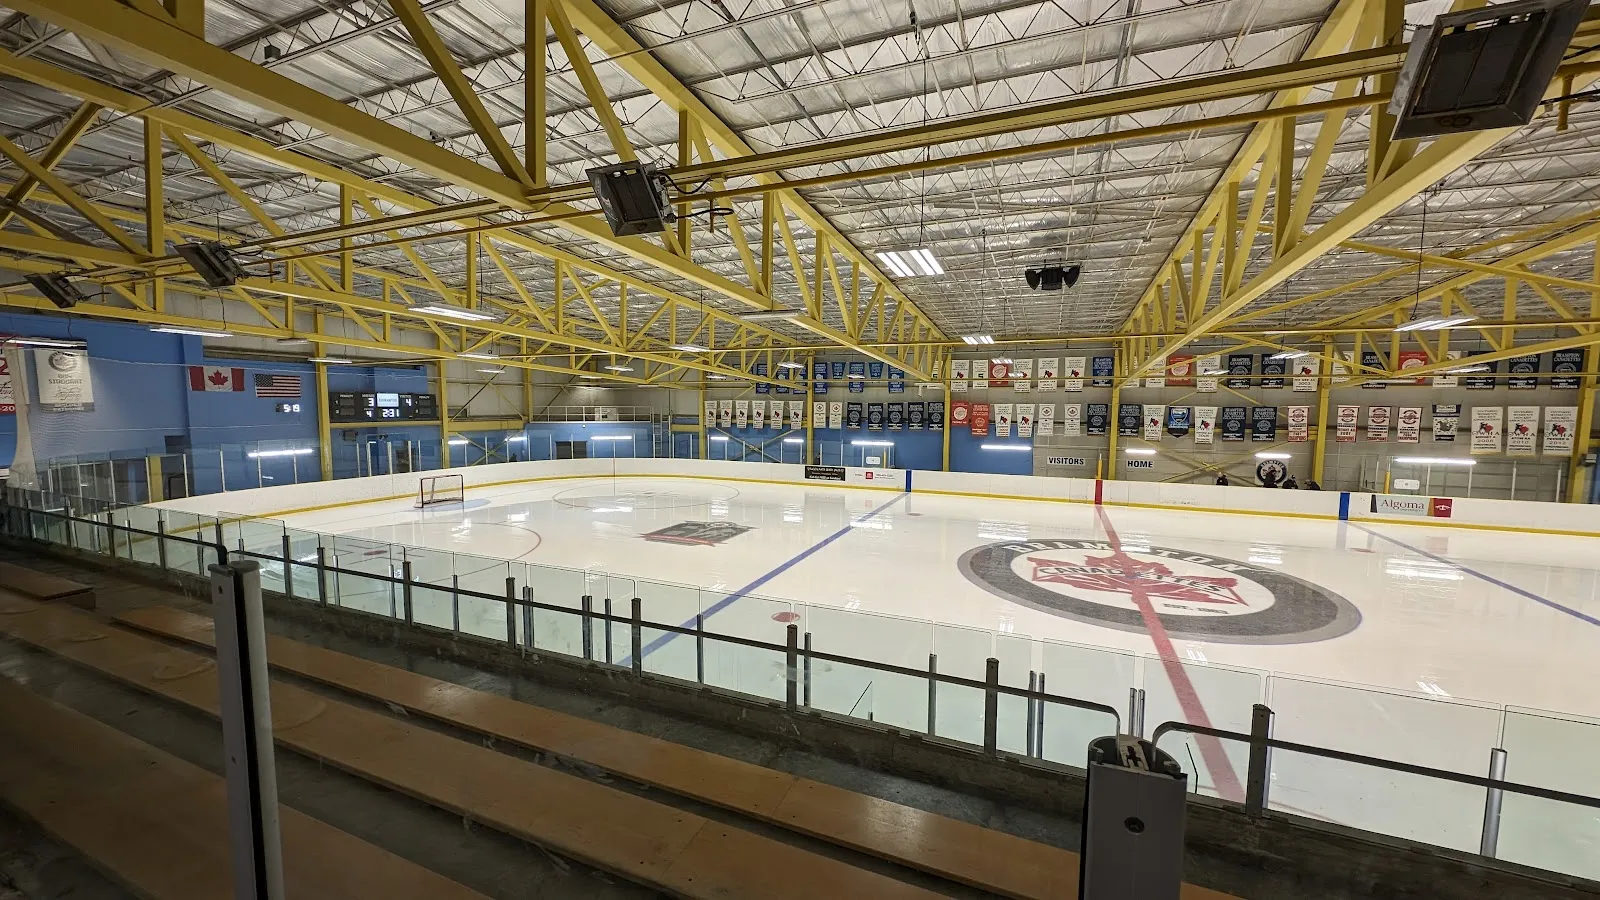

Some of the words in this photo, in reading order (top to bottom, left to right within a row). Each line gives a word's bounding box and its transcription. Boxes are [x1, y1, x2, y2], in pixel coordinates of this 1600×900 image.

[368, 398, 375, 407] 3
[405, 398, 412, 407] 4
[366, 410, 372, 418] 4
[1048, 457, 1085, 465] VISITORS
[1127, 460, 1154, 468] HOME
[1380, 499, 1425, 510] Algoma
[1001, 540, 1262, 573] BRAMTON
